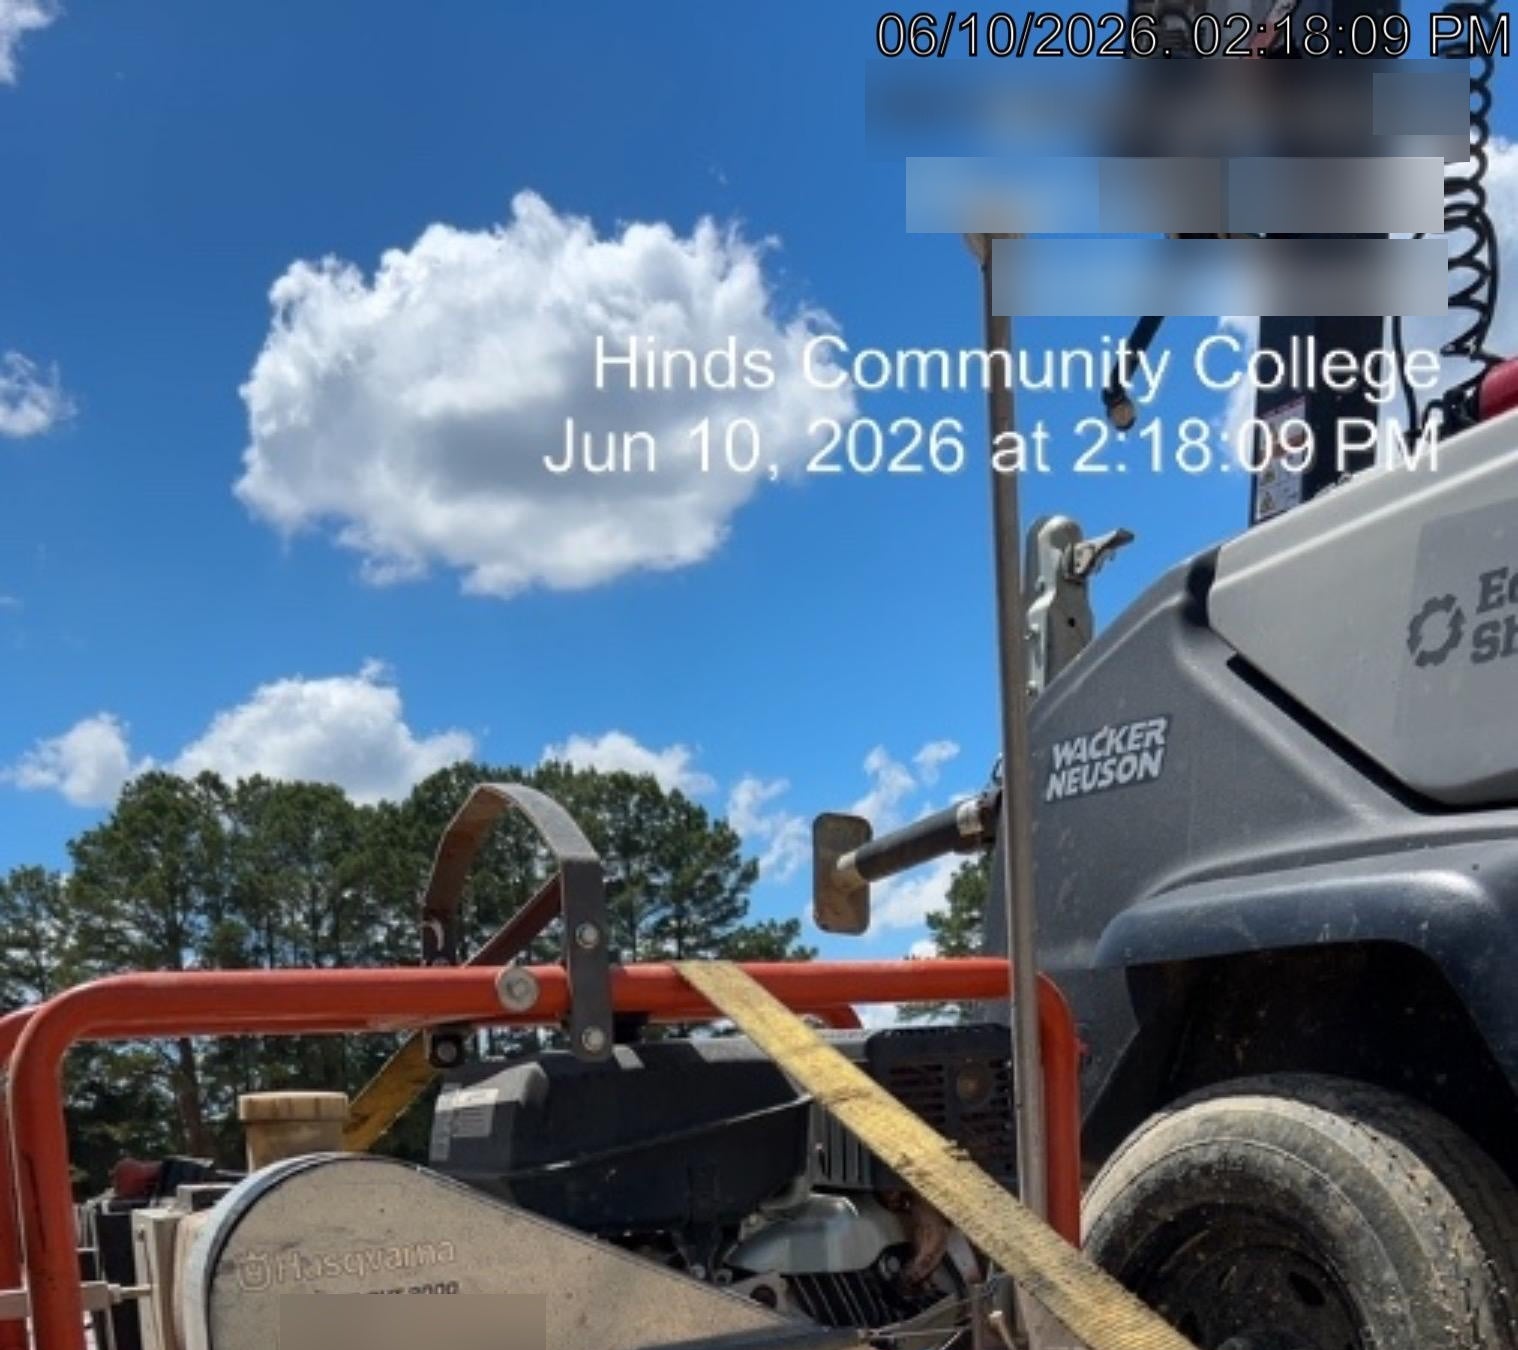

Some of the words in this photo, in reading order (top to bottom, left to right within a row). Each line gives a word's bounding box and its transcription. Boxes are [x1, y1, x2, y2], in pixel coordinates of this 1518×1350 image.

[1053, 717, 1168, 771] WACKER
[1046, 746, 1164, 802] NEUSON
[277, 1240, 456, 1282] Husqvarna
